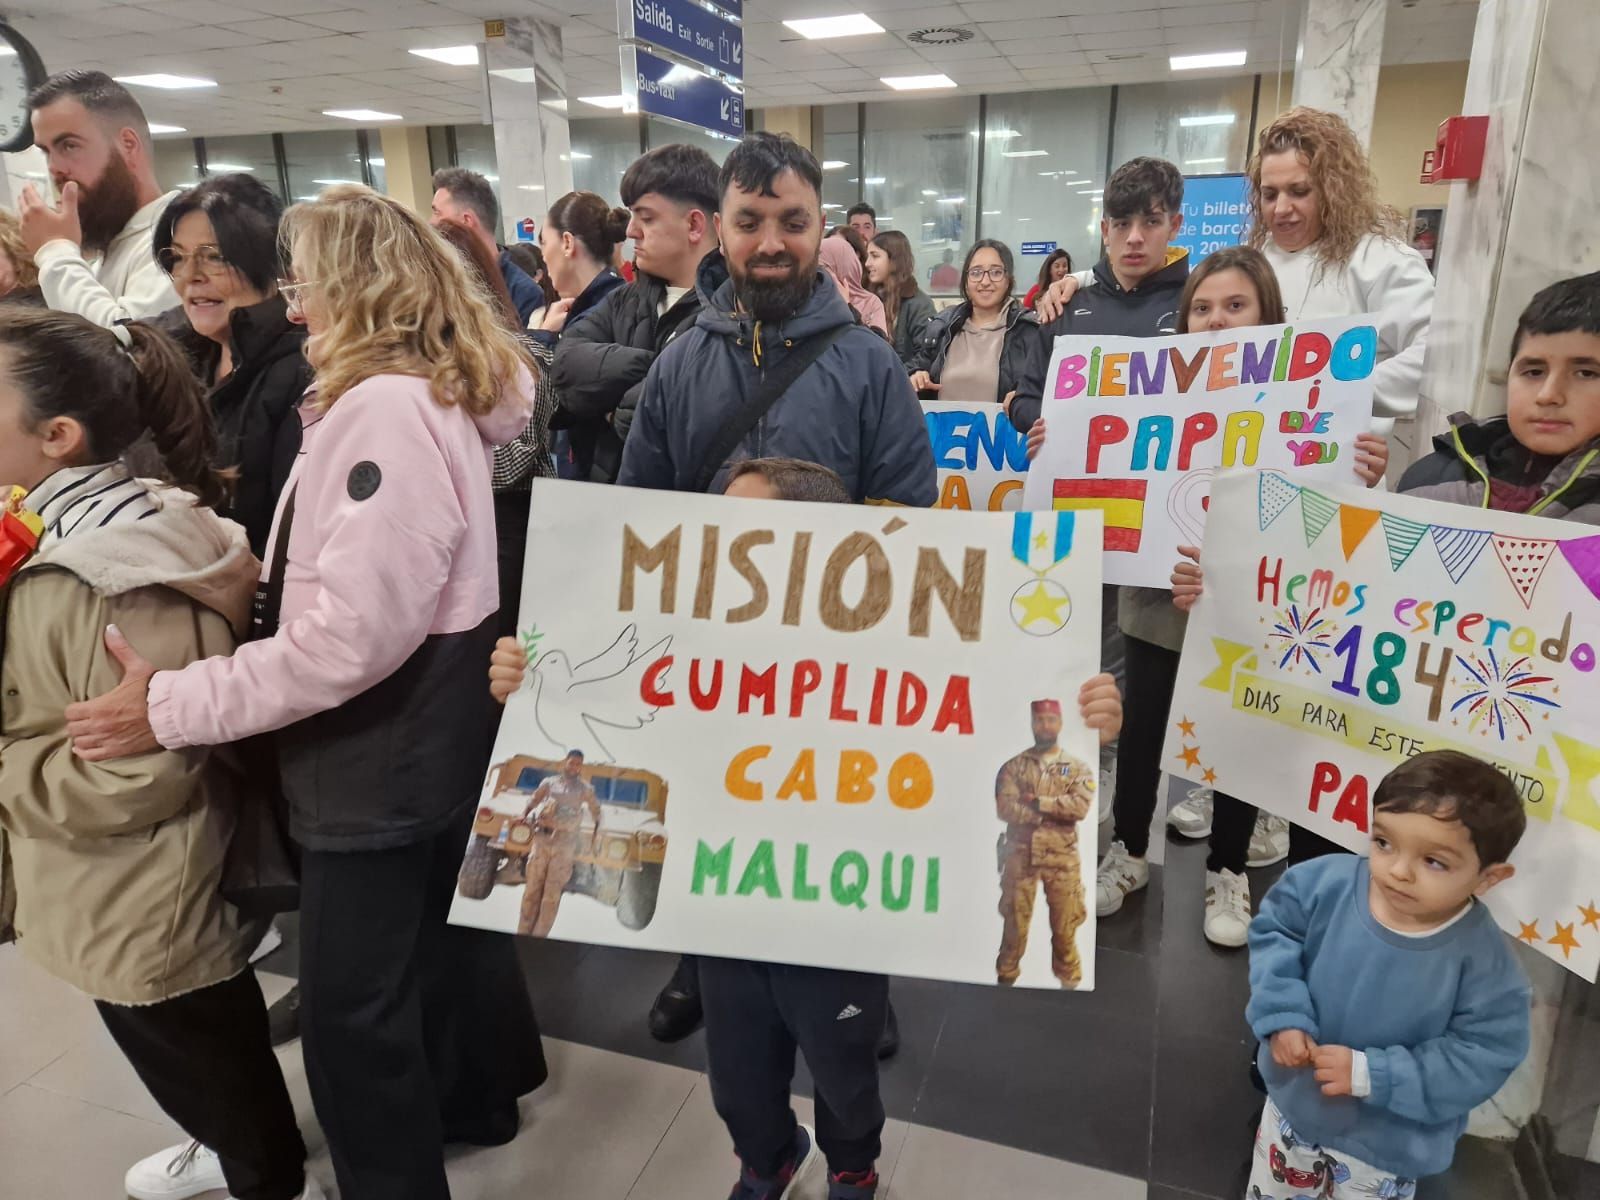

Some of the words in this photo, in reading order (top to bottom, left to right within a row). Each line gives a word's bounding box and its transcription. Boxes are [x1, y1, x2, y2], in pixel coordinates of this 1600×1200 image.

[636, 0, 673, 33] Salida
[678, 24, 692, 42] Exit
[695, 32, 715, 51] Sortie
[1182, 203, 1198, 216] Tu
[1202, 222, 1250, 236] barco
[1085, 391, 1266, 474] PAPÁ
[1279, 411, 1334, 433] LOVE
[1286, 440, 1339, 467] YOU
[617, 516, 986, 642] MISIÓN
[1257, 555, 1369, 616] Hemos
[1393, 597, 1597, 673] esperado
[639, 656, 974, 735] CUMPLIDA
[1331, 625, 1453, 722] 184
[1243, 687, 1281, 714] DIAS
[1302, 702, 1348, 736] PARA
[1368, 726, 1424, 757] ESTE
[725, 744, 934, 809] CABO
[1308, 761, 1369, 833] PA
[690, 837, 940, 912] MALQUI
